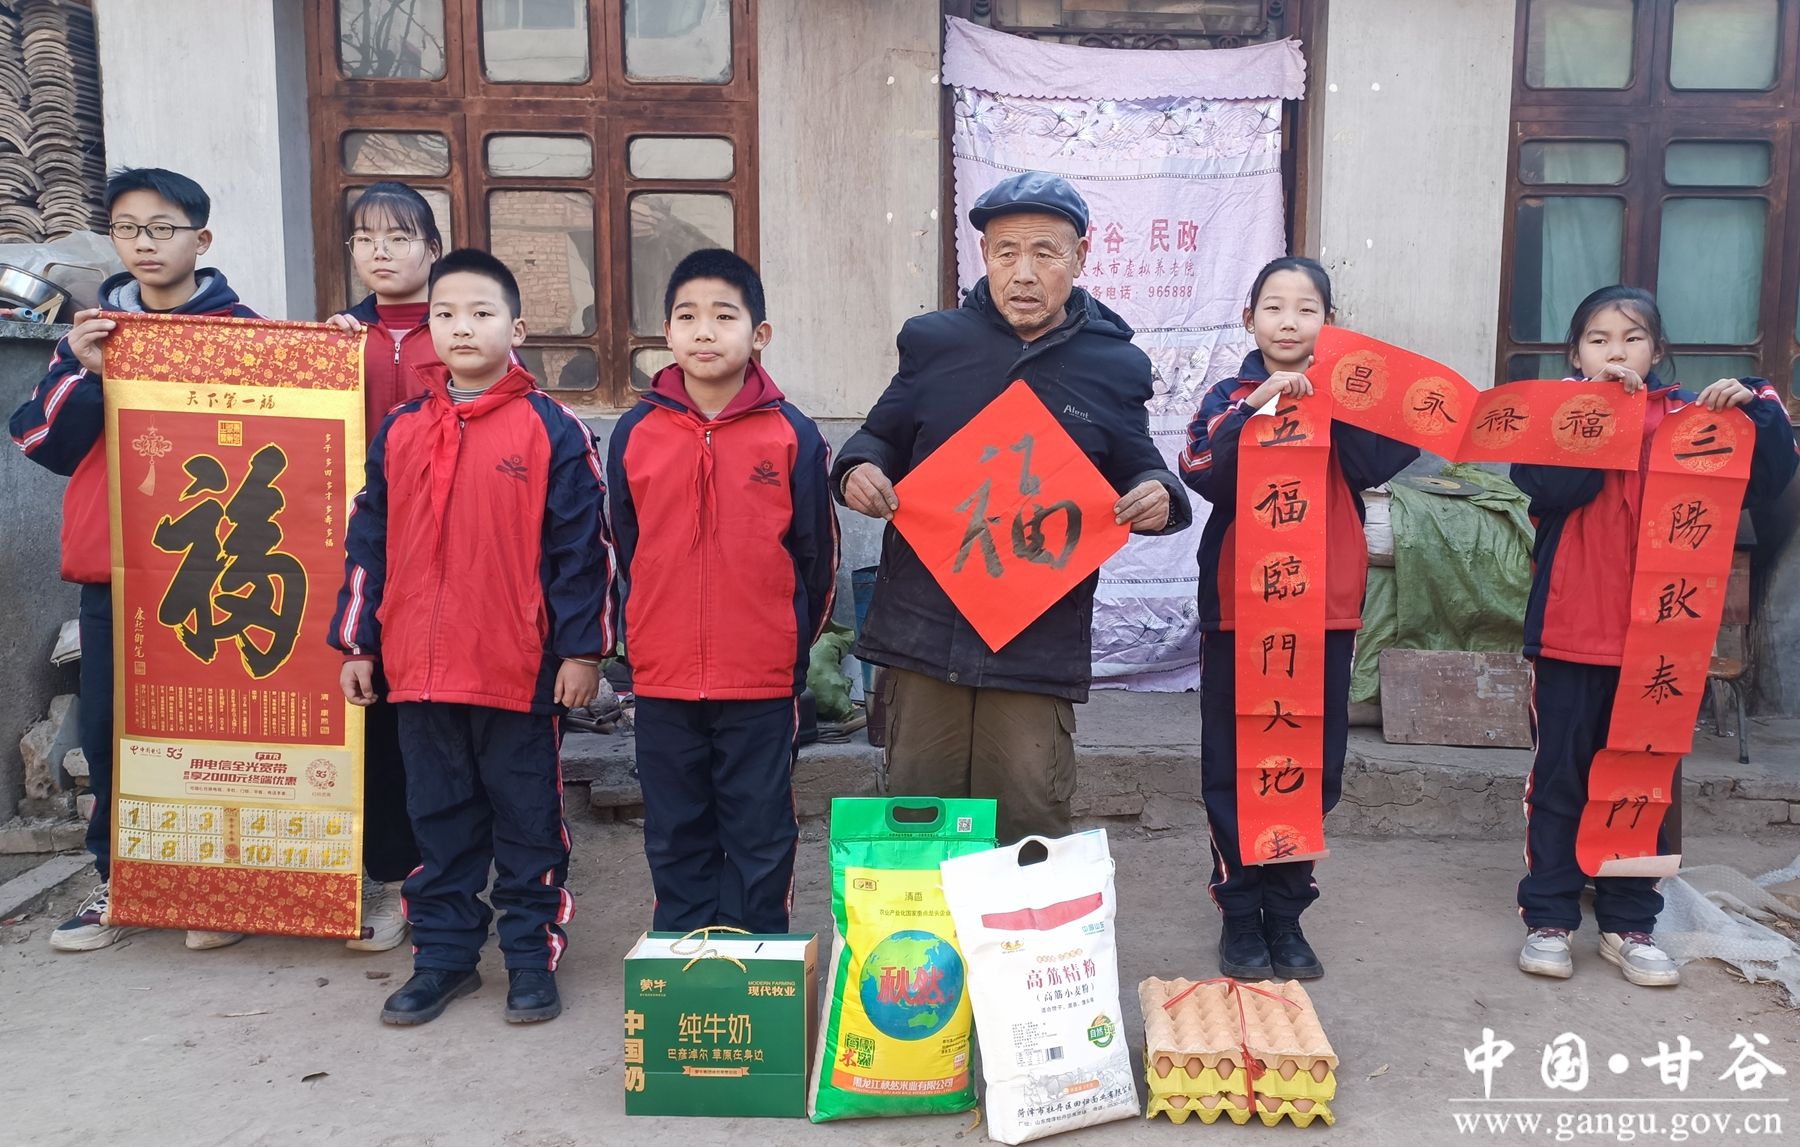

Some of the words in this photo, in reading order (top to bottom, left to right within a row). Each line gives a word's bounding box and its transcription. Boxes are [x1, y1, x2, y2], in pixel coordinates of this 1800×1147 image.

[1150, 218, 1199, 252] 民政
[1148, 285, 1193, 298] 965888
[186, 390, 276, 410] 天下第一福
[952, 431, 1083, 579] 福
[151, 441, 309, 681] 福
[189, 758, 288, 774] 用电信全光宽带
[128, 807, 140, 825] 1
[160, 810, 178, 829] 2
[199, 811, 214, 831] 3
[250, 815, 266, 834] 4
[287, 816, 305, 835] 5
[326, 817, 343, 836] 6
[128, 836, 142, 855] 7
[161, 840, 177, 858] 8
[199, 841, 214, 859] 9
[245, 845, 273, 864] 10
[282, 847, 309, 865] 11
[1026, 958, 1096, 990] 高筋精粉
[640, 978, 667, 993] 蒙牛
[747, 985, 796, 997] 现代牧业
[678, 1013, 752, 1045] 纯牛奶
[624, 1009, 646, 1093] 中国奶
[712, 1048, 765, 1063] 草原在身边
